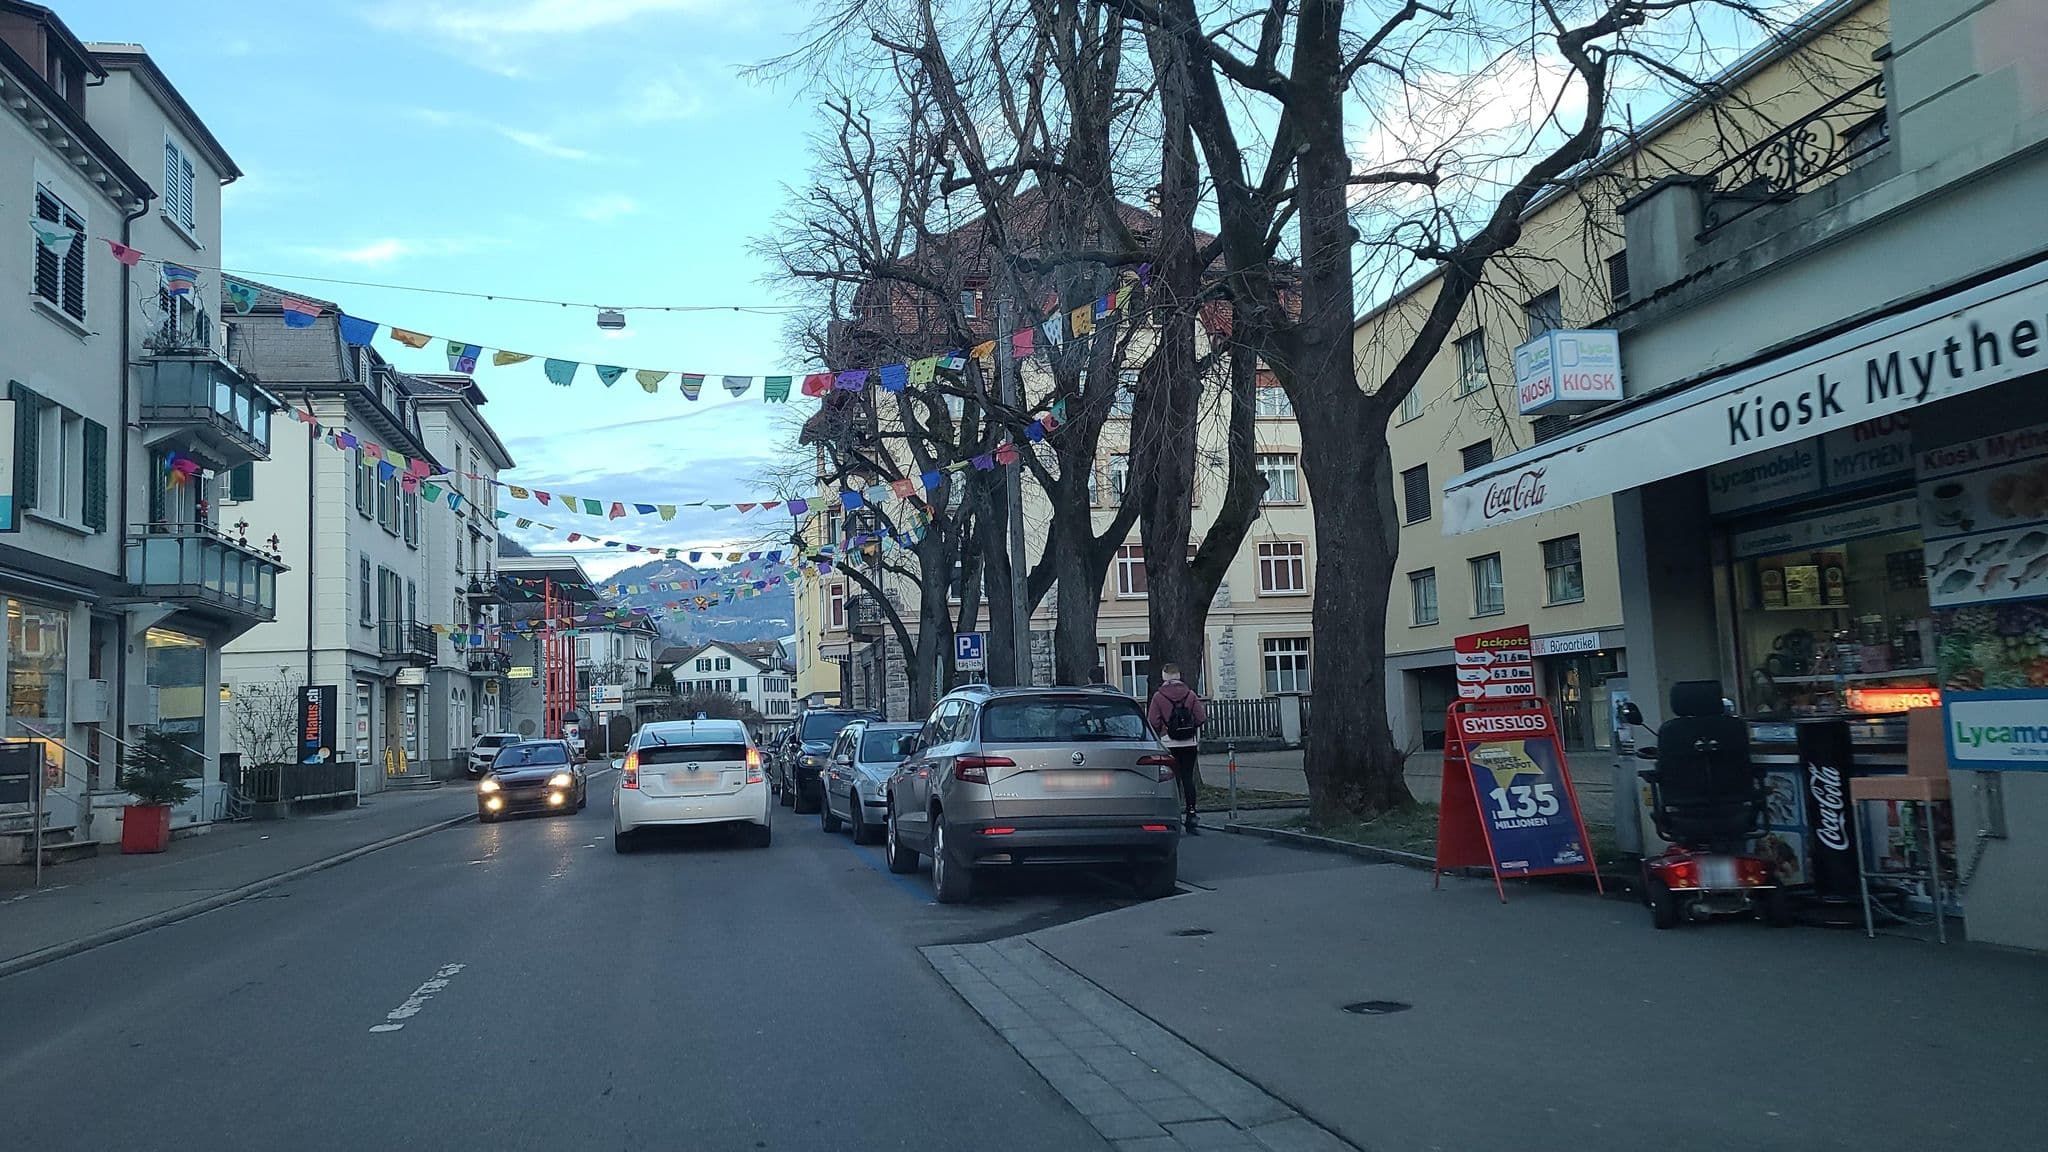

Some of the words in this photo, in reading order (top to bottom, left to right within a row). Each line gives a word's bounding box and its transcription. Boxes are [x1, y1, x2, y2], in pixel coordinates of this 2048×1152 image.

[1521, 376, 1552, 404] KIOSK
[1563, 374, 1615, 391] KIOSK
[1728, 373, 1845, 446] Kiosk
[1866, 319, 2048, 404] Mythe
[1710, 451, 1812, 492] Lycamobile
[1475, 637, 1529, 649] Jackpots
[1551, 636, 1596, 652] Büroartikel
[1464, 715, 1546, 733] SWISSLOS
[1489, 784, 1559, 819] 135
[1495, 818, 1548, 830] MILLIONEN
